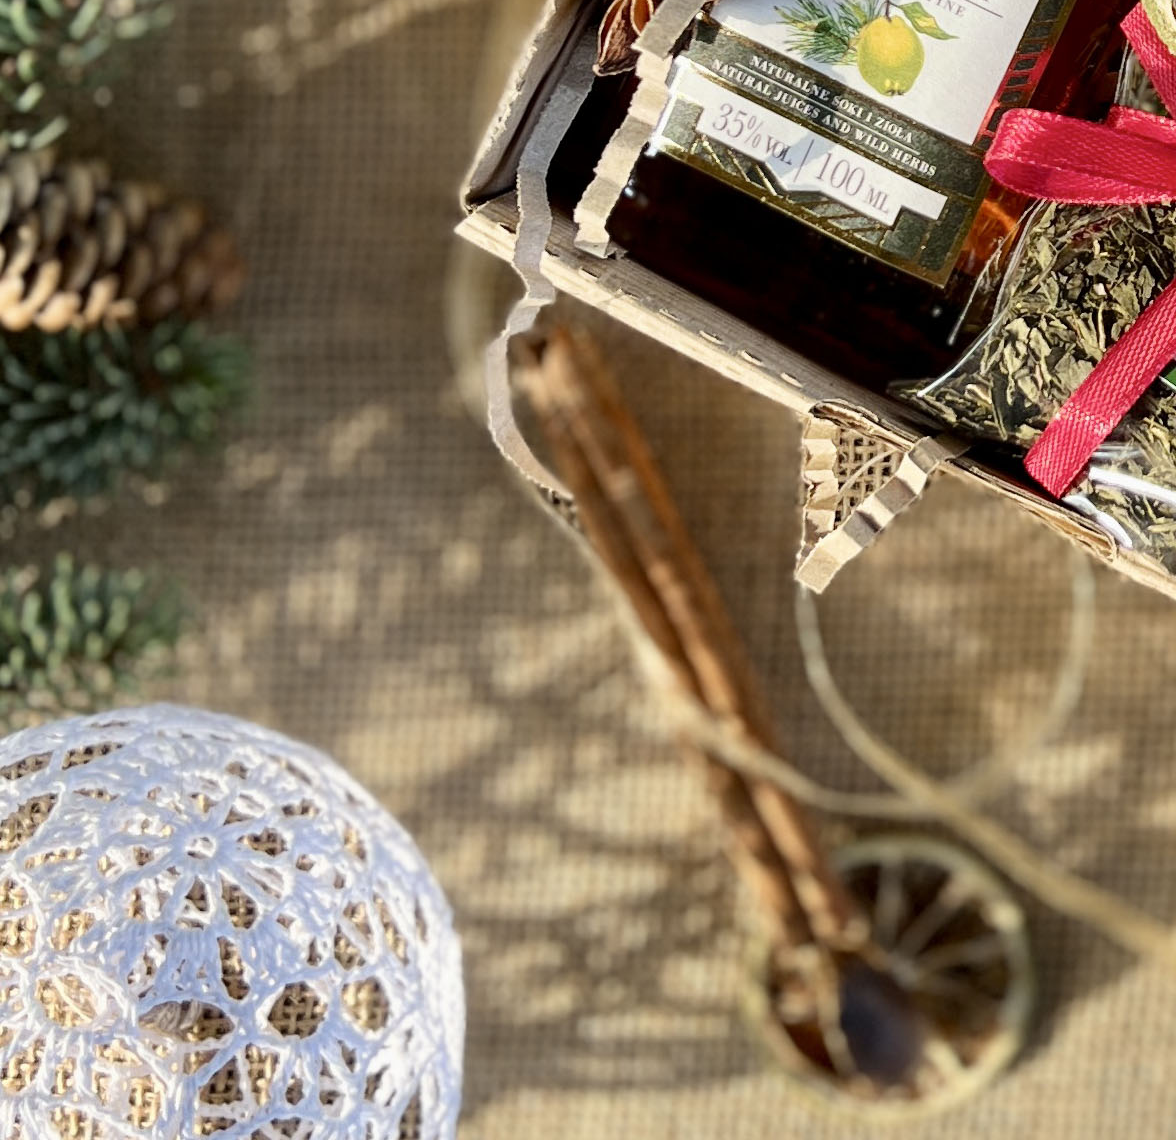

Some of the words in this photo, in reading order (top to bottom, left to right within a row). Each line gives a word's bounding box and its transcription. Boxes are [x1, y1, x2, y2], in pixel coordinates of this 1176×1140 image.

[711, 58, 771, 98] NATURAL
[773, 89, 820, 120] JUICES
[821, 113, 851, 136] AND
[853, 129, 889, 155] WILD
[890, 147, 938, 177] HERBS
[749, 55, 830, 100] NATURALNE
[831, 93, 864, 119] SOKI
[874, 115, 914, 144] ZIOŁA
[711, 103, 764, 148] 35%
[815, 152, 866, 196] 100
[865, 187, 889, 213] ML
